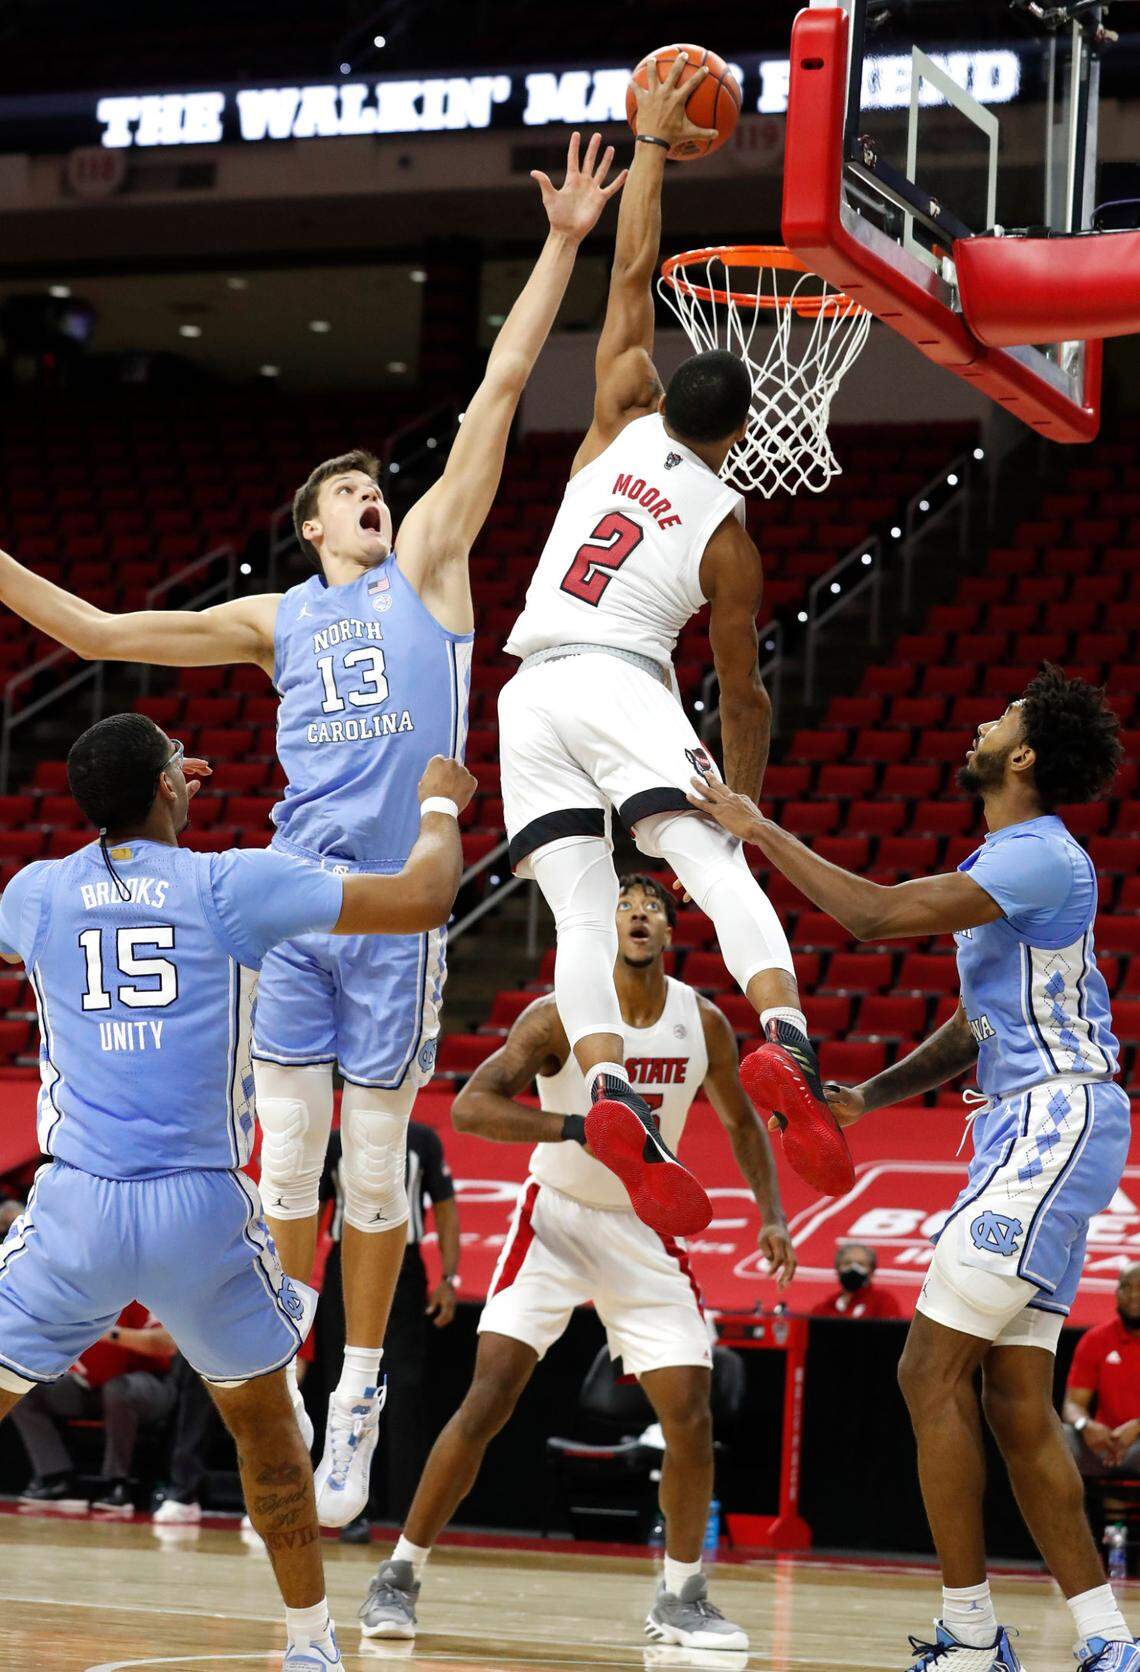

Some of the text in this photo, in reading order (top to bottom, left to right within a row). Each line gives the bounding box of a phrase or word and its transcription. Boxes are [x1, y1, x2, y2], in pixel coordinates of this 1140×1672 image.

[97, 91, 225, 149] THE
[236, 74, 511, 140] WALKIN'
[612, 473, 682, 531] MOORE
[560, 511, 644, 608] 2
[313, 618, 384, 655] NORTH
[316, 645, 390, 714] 13
[307, 709, 415, 744] CAROLINA
[80, 876, 169, 910] BROOKS
[79, 926, 179, 1011] 15
[99, 1021, 164, 1051] UNITY
[624, 1057, 690, 1084] STATE
